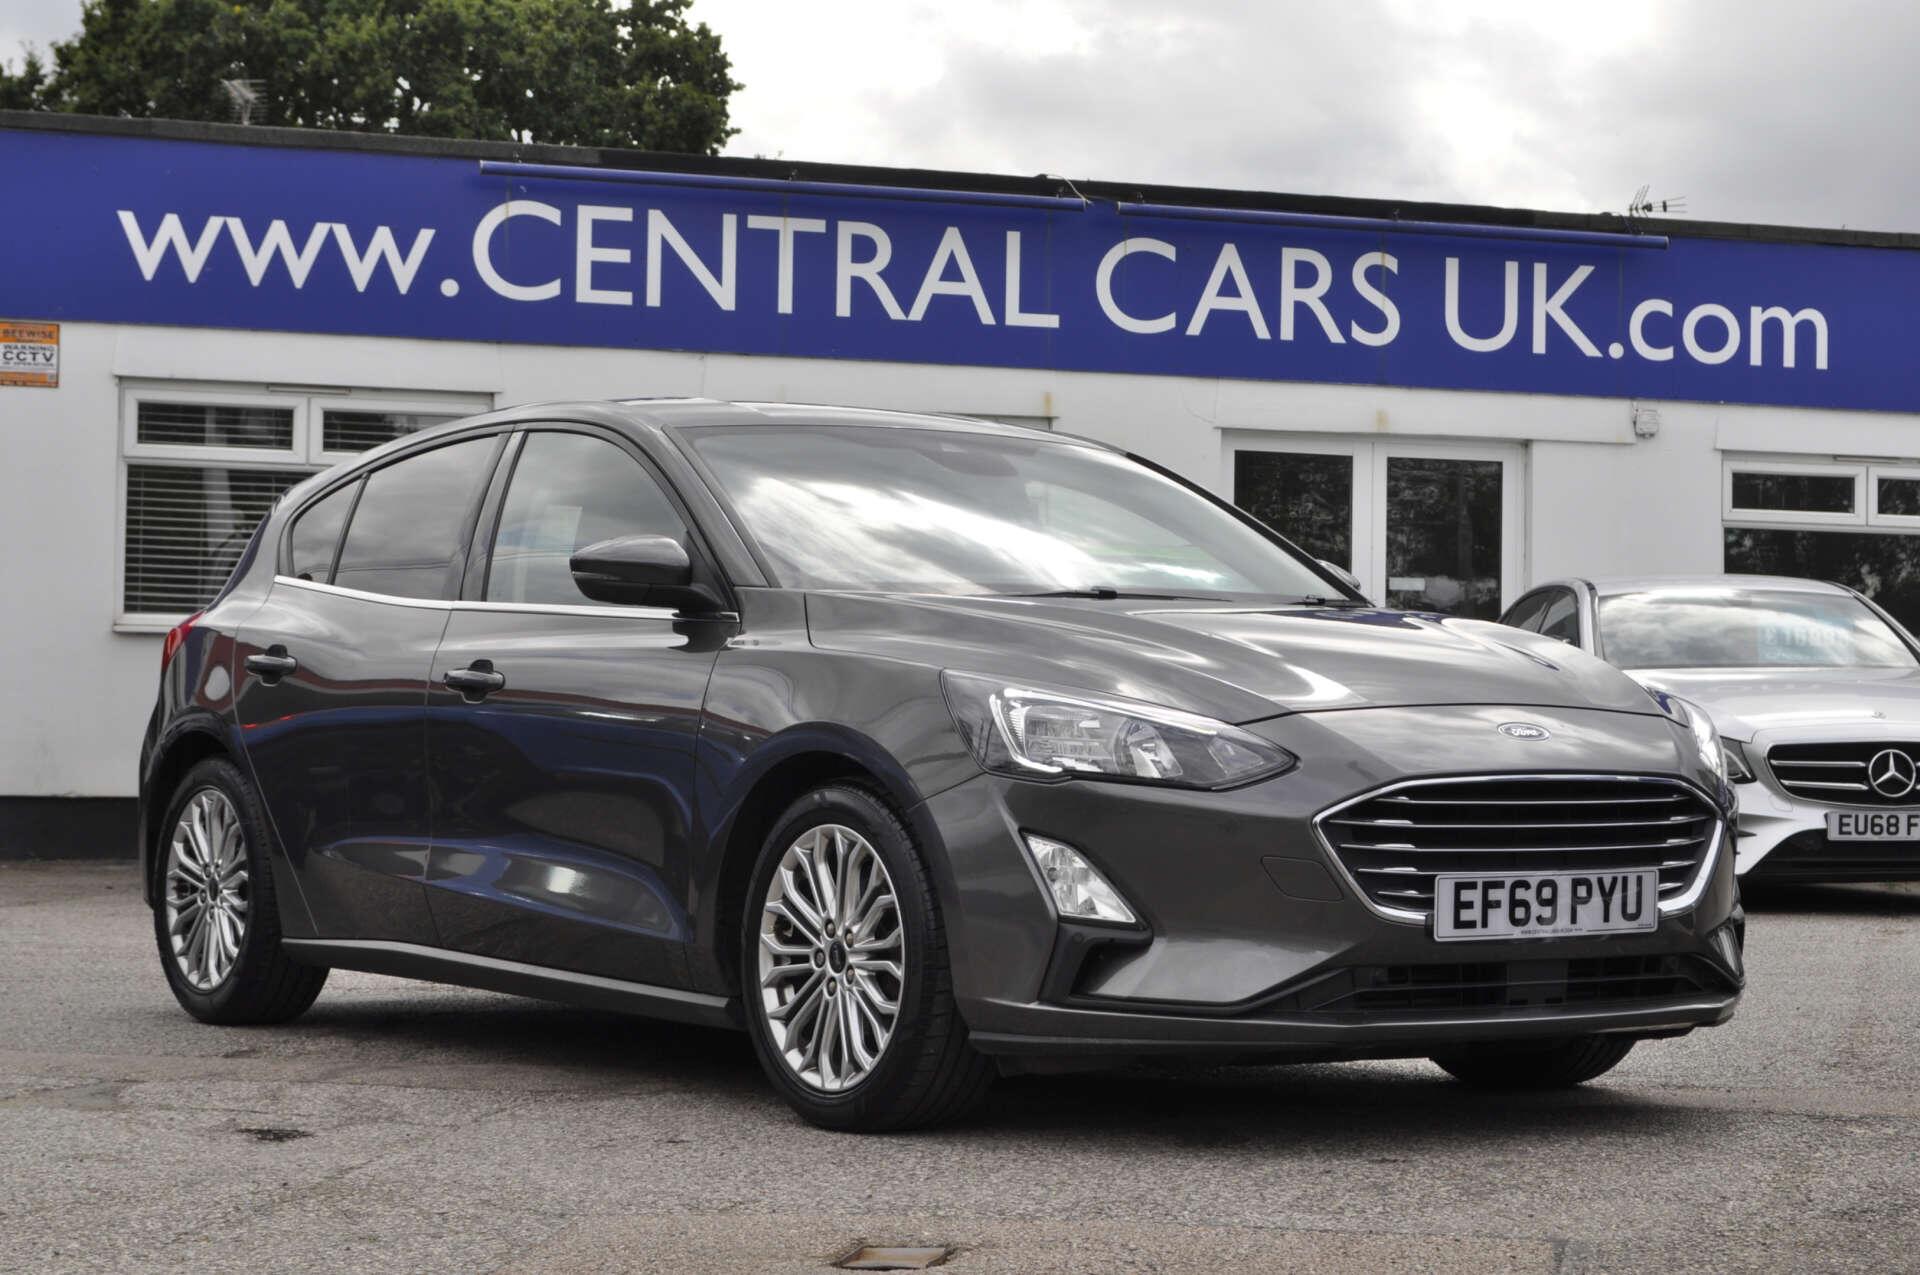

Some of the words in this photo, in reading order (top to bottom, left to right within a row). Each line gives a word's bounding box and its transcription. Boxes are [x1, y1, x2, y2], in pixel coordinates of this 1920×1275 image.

[116, 199, 1060, 328] www.CENTRAL
[1095, 237, 1401, 347] CARS
[1444, 256, 1829, 370] UK.com
[3, 350, 54, 362] CCTV
[1838, 814, 1899, 836] EU68
[1453, 879, 1558, 929] EF69
[1570, 875, 1643, 925] PYU
